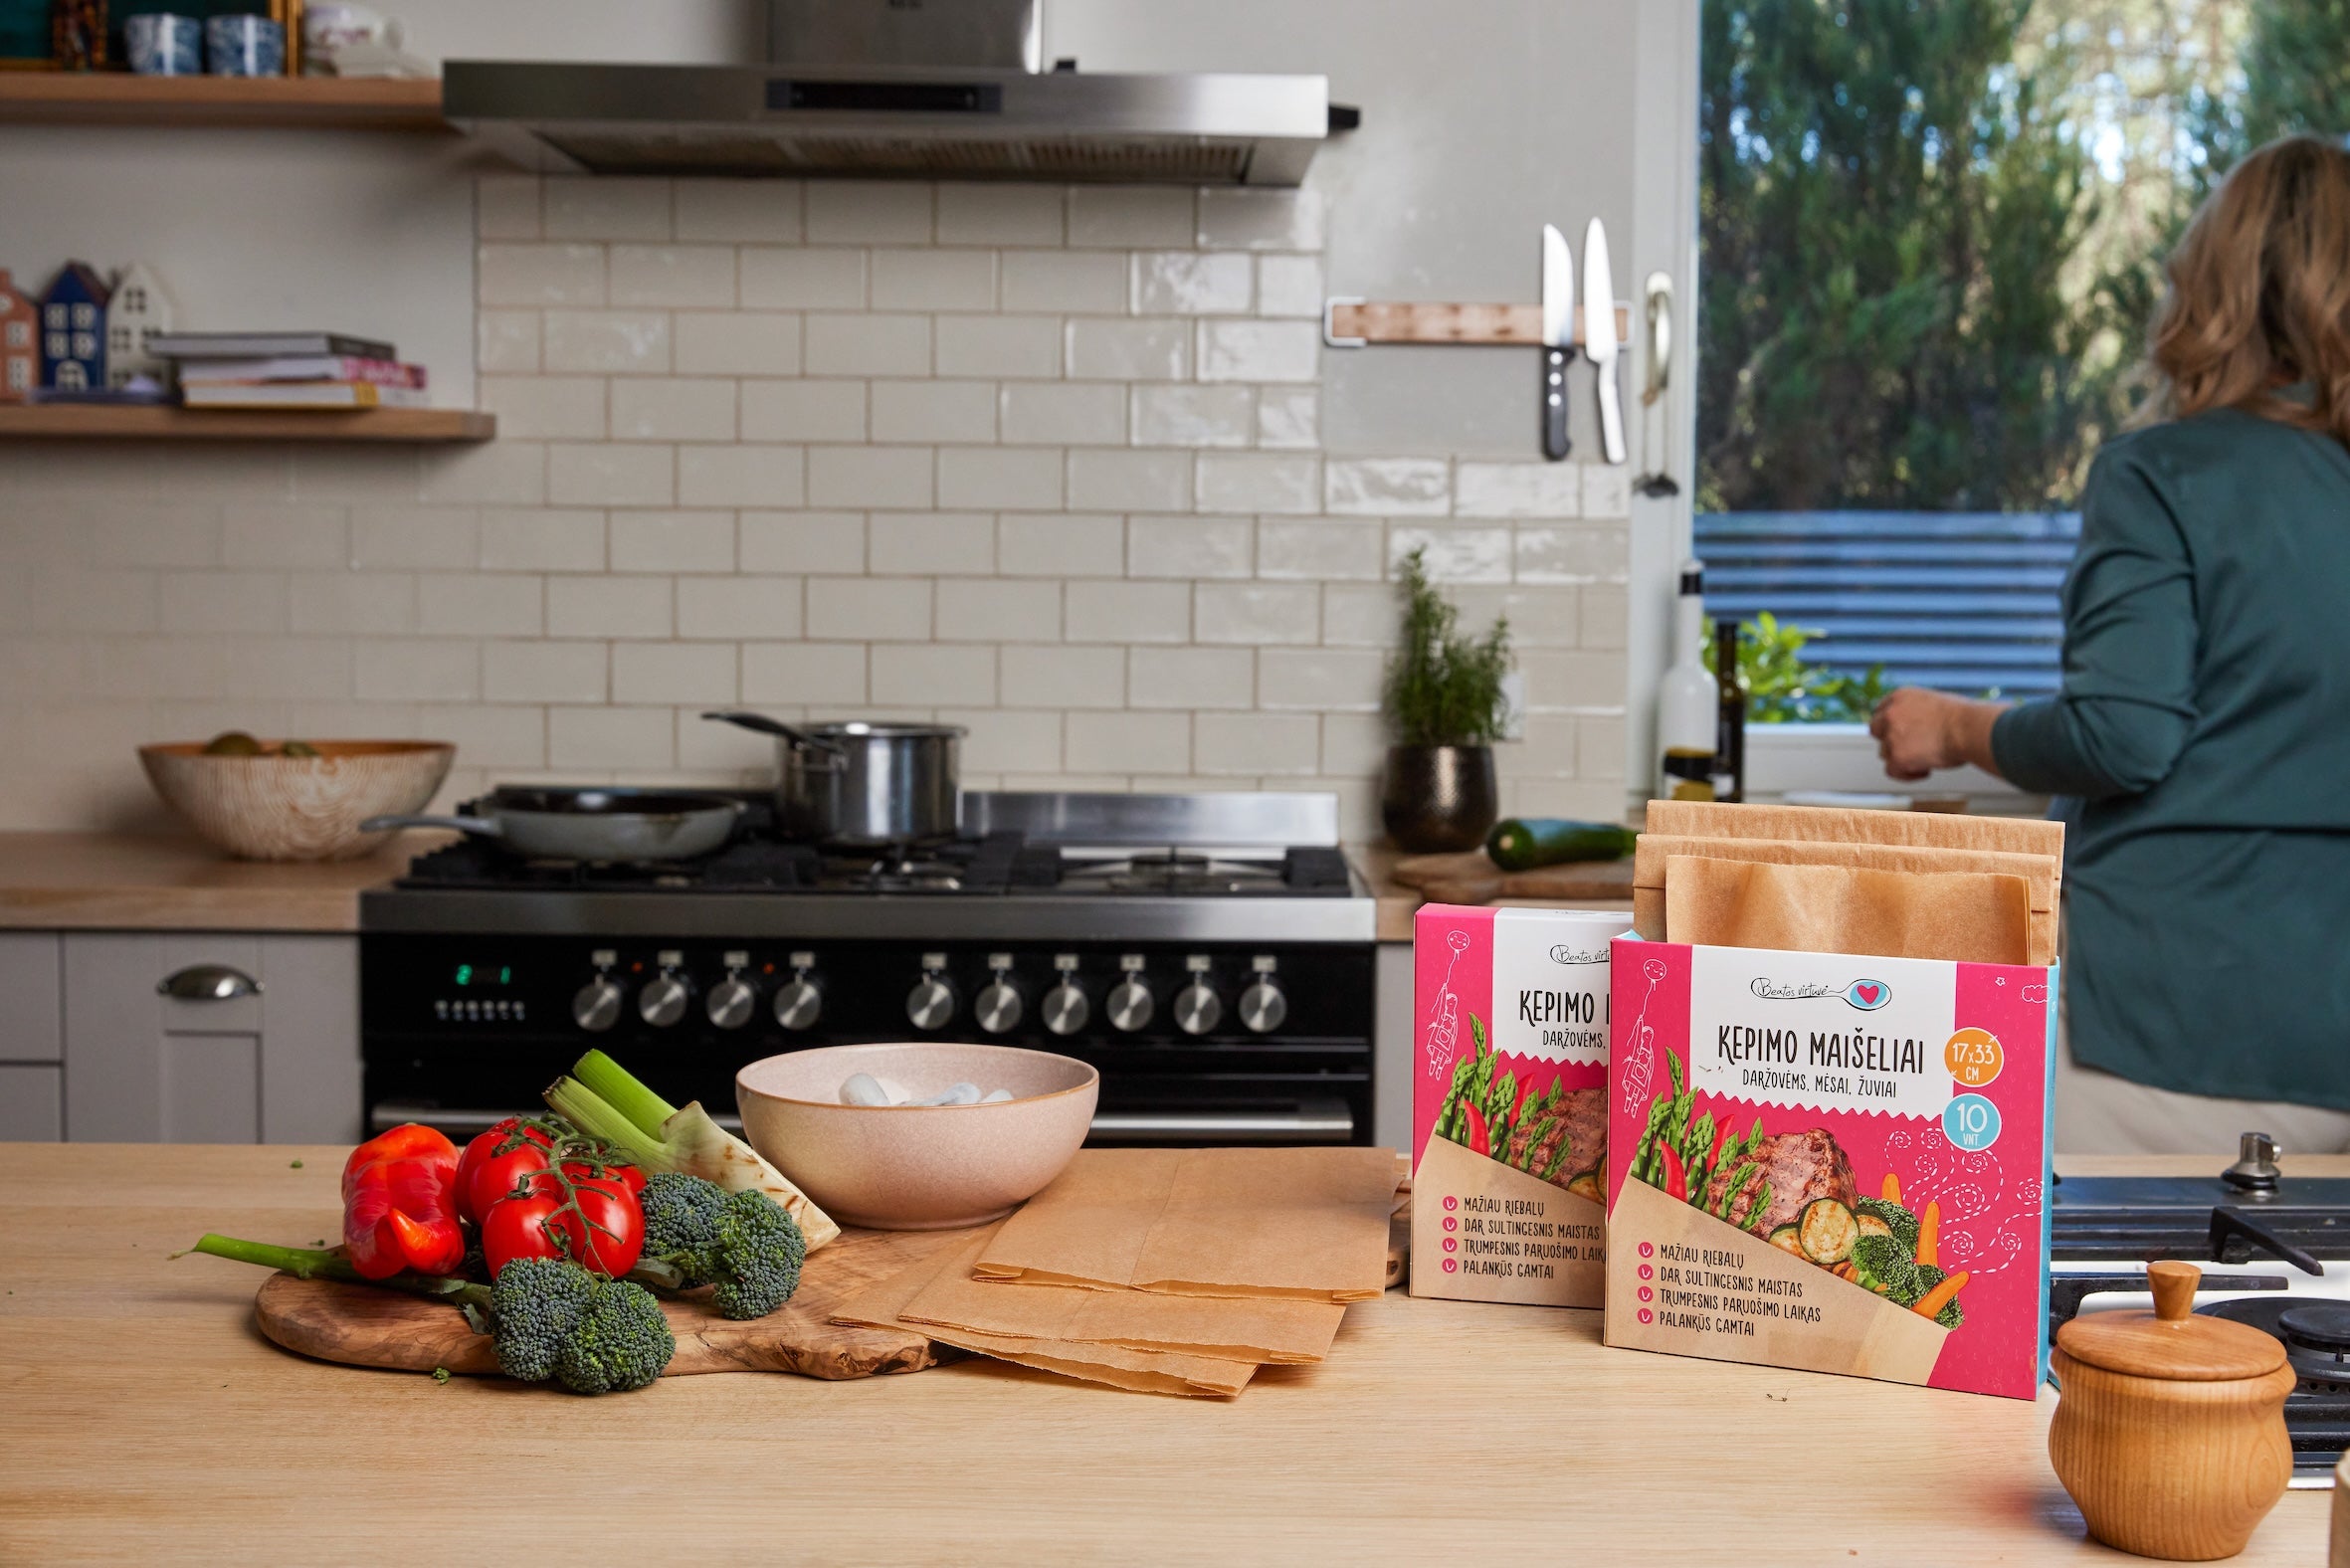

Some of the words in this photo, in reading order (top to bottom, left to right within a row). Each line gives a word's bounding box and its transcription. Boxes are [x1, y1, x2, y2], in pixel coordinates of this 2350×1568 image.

[1751, 977, 1795, 997] Beatos
[1798, 984, 1829, 996] virtuvė
[1520, 990, 1594, 1027] KEPIMO
[1543, 1028, 1606, 1049] DARŽOVĖMS,
[1718, 1025, 1798, 1065] KEPIMO
[1810, 1027, 1924, 1074] MAIŠELIAI
[1952, 1042, 1995, 1065] 17x33
[1742, 1069, 1810, 1092] DARŽOVĖMS,
[1815, 1073, 1851, 1094] MĖSAI,
[1858, 1075, 1896, 1098] ŽUVIAI
[1965, 1066, 1980, 1081] CM
[1956, 1102, 1988, 1133] 10
[1963, 1133, 1981, 1146] VNT.
[1464, 1195, 1501, 1213] MAŽIAU
[1504, 1200, 1544, 1217] RIEBALŲ
[1464, 1218, 1484, 1236] DAR
[1488, 1220, 1553, 1238] SULTINGESNIS
[1557, 1224, 1600, 1241] MAISTAS
[1464, 1239, 1520, 1257] TRUMPESNIS
[1524, 1242, 1578, 1261] PARUOŠIMO
[1660, 1243, 1698, 1263] MAŽIAU
[1702, 1249, 1744, 1270] RIEBALŲ
[1464, 1260, 1512, 1278] PALANKŪS
[1517, 1264, 1554, 1279] GAMTAI
[1661, 1267, 1681, 1286] DAR
[1685, 1270, 1754, 1291] SULTINGESNIS
[1758, 1277, 1803, 1298] MAISTAS
[1660, 1288, 1718, 1310] TRUMPESNIS
[1723, 1296, 1780, 1317] PARUOŠIMO
[1784, 1303, 1821, 1324] LAIKAS
[1660, 1310, 1711, 1333] PALANKŪS
[1715, 1318, 1755, 1337] GAMTAI
